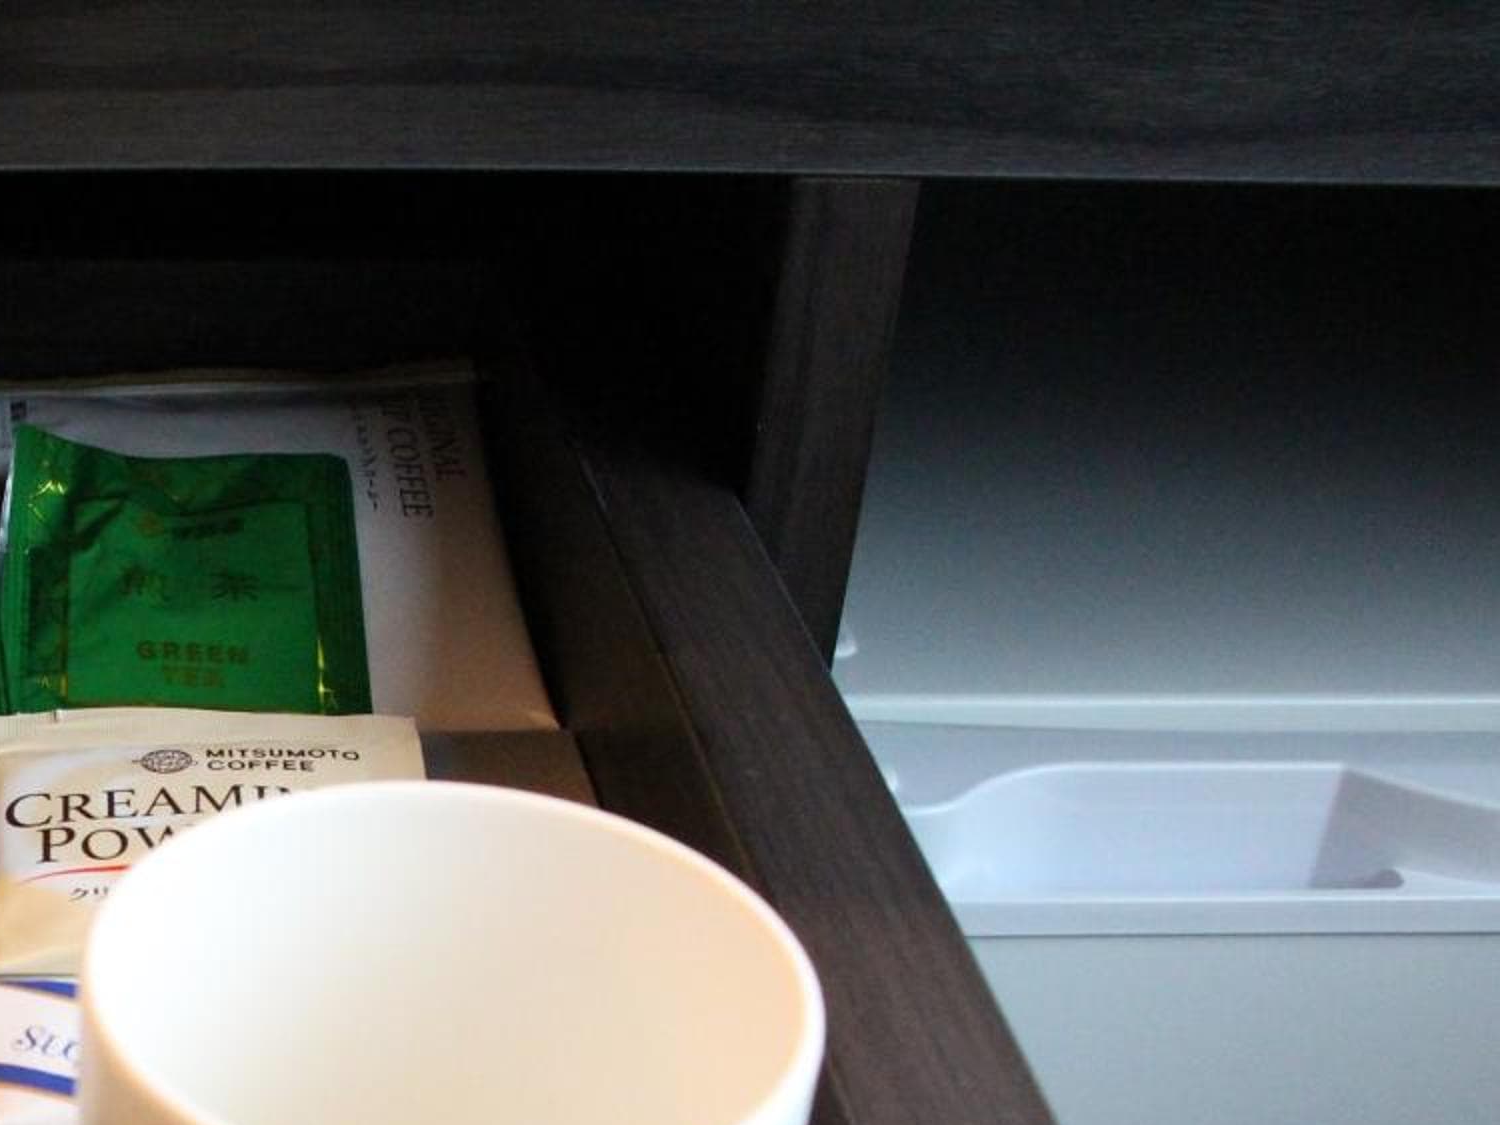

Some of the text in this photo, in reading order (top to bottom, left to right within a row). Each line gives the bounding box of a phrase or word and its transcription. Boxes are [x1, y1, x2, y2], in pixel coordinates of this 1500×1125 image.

[386, 427, 434, 517] COFFEE
[136, 640, 248, 664] GREEN
[205, 748, 360, 761] MITSUMOTO
[207, 760, 316, 773] COFFEE
